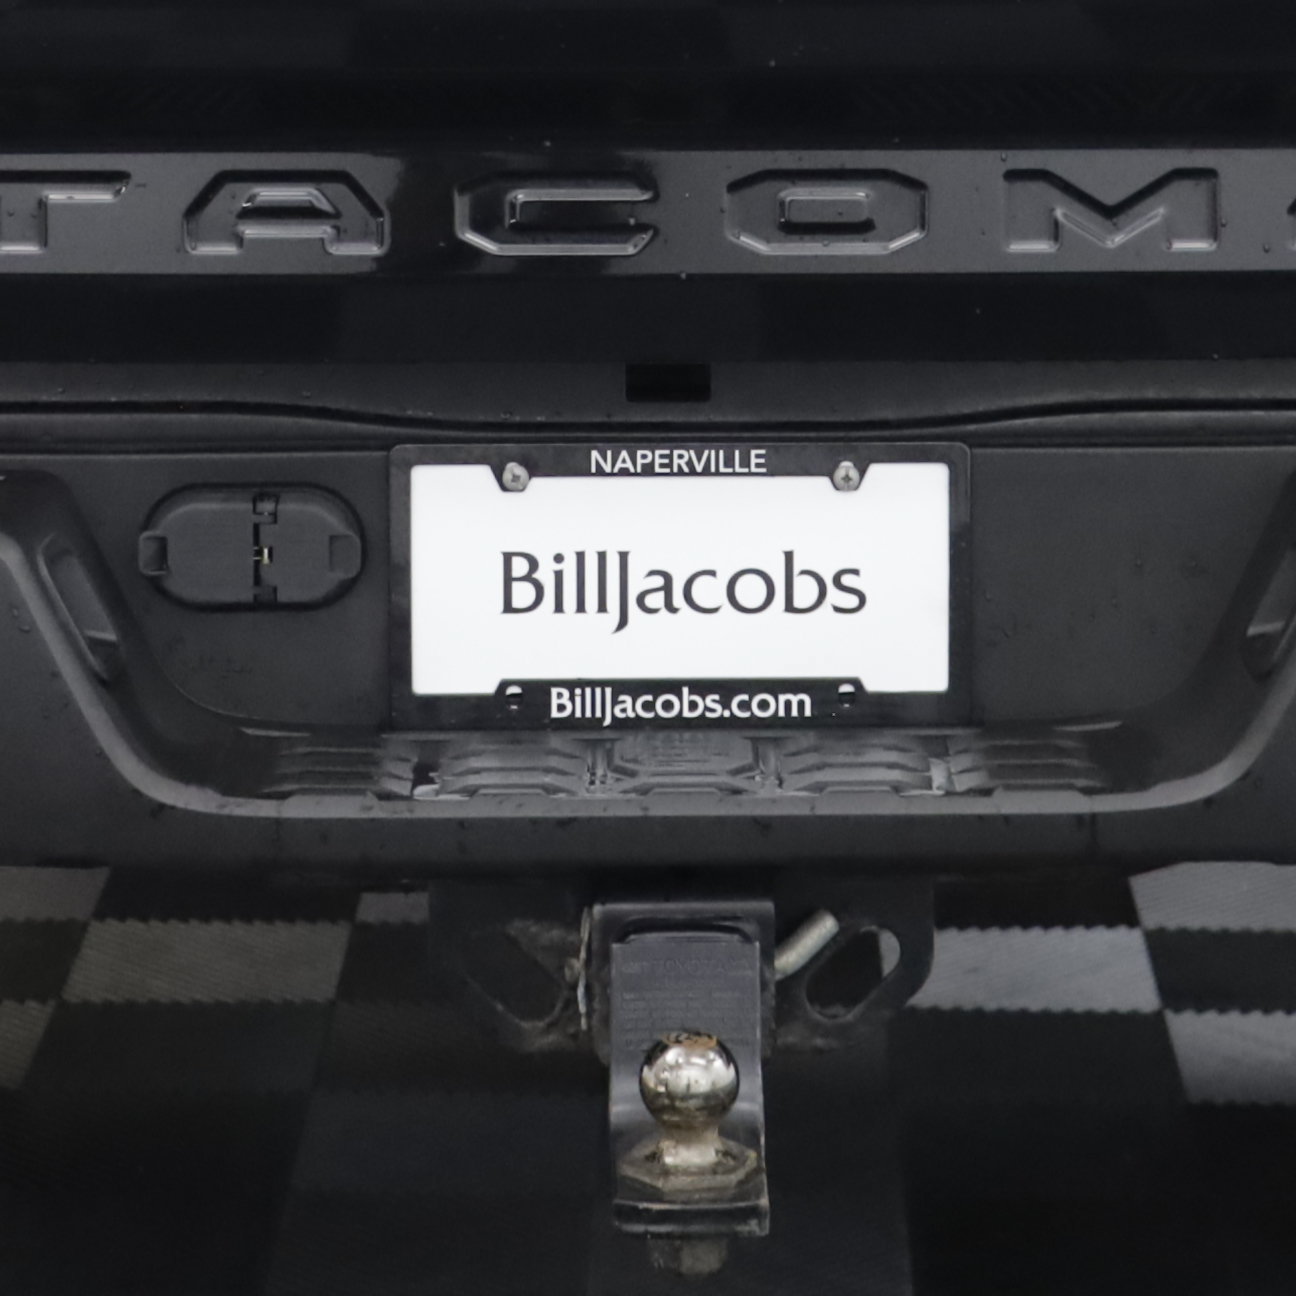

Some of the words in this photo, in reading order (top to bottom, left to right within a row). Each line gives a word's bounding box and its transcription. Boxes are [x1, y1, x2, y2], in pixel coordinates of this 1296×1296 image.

[589, 449, 767, 474] NAPERVILLE
[500, 549, 868, 635] BillJacobs
[549, 686, 813, 727] BillJacobs.com
